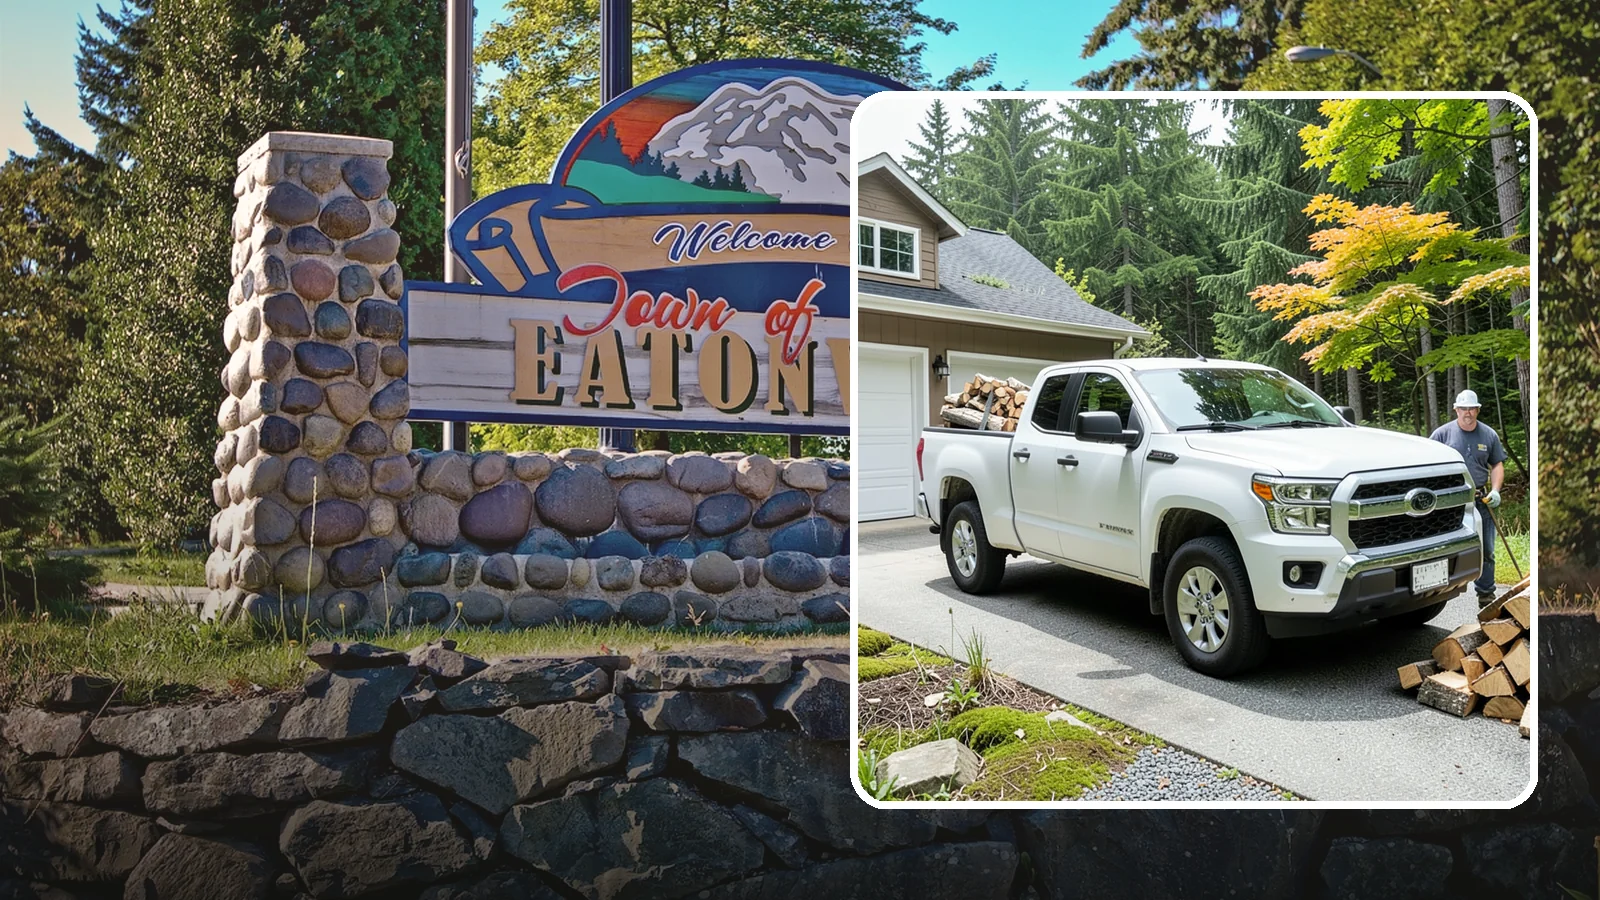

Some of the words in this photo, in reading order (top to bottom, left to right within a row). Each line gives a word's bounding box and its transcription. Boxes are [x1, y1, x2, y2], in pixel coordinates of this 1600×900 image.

[653, 220, 837, 263] Welcome
[556, 263, 736, 337] Town
[764, 278, 826, 365] of
